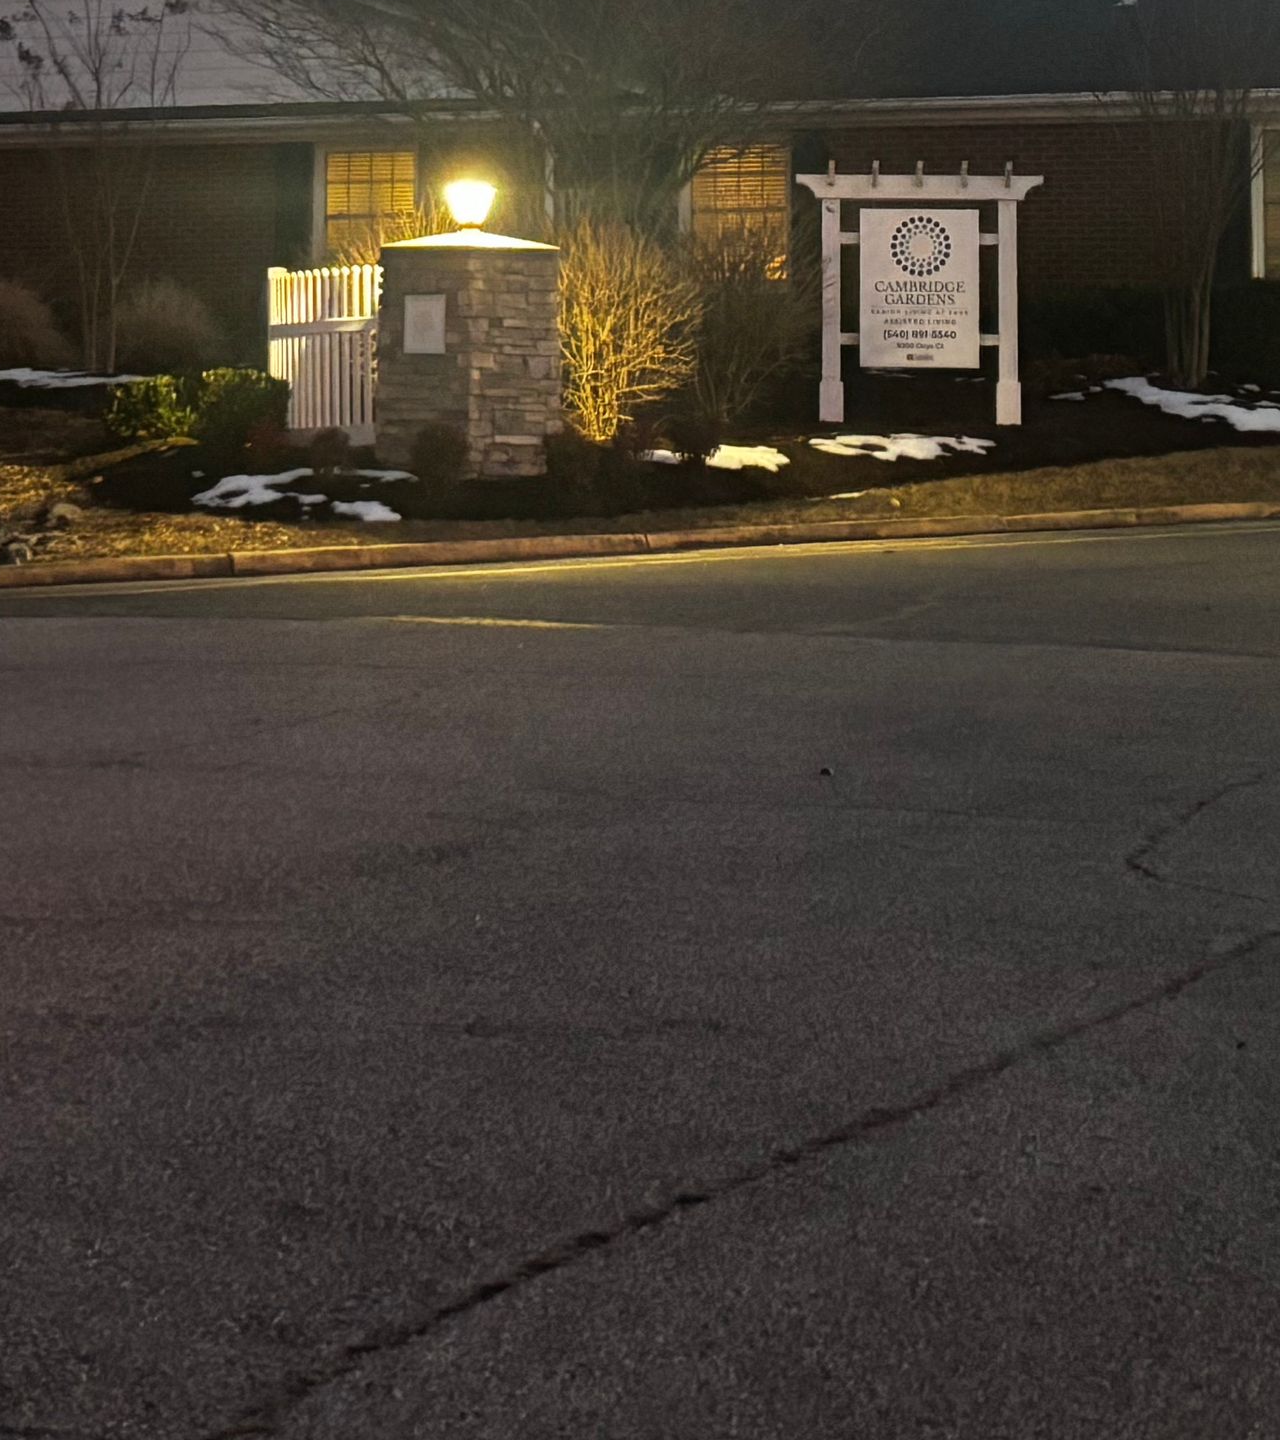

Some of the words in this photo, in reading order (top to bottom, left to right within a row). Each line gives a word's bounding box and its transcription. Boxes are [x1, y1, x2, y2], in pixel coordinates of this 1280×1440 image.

[874, 280, 966, 293] CAMBRIDGE
[884, 293, 956, 305] GARDENS
[883, 329, 909, 341] (540)
